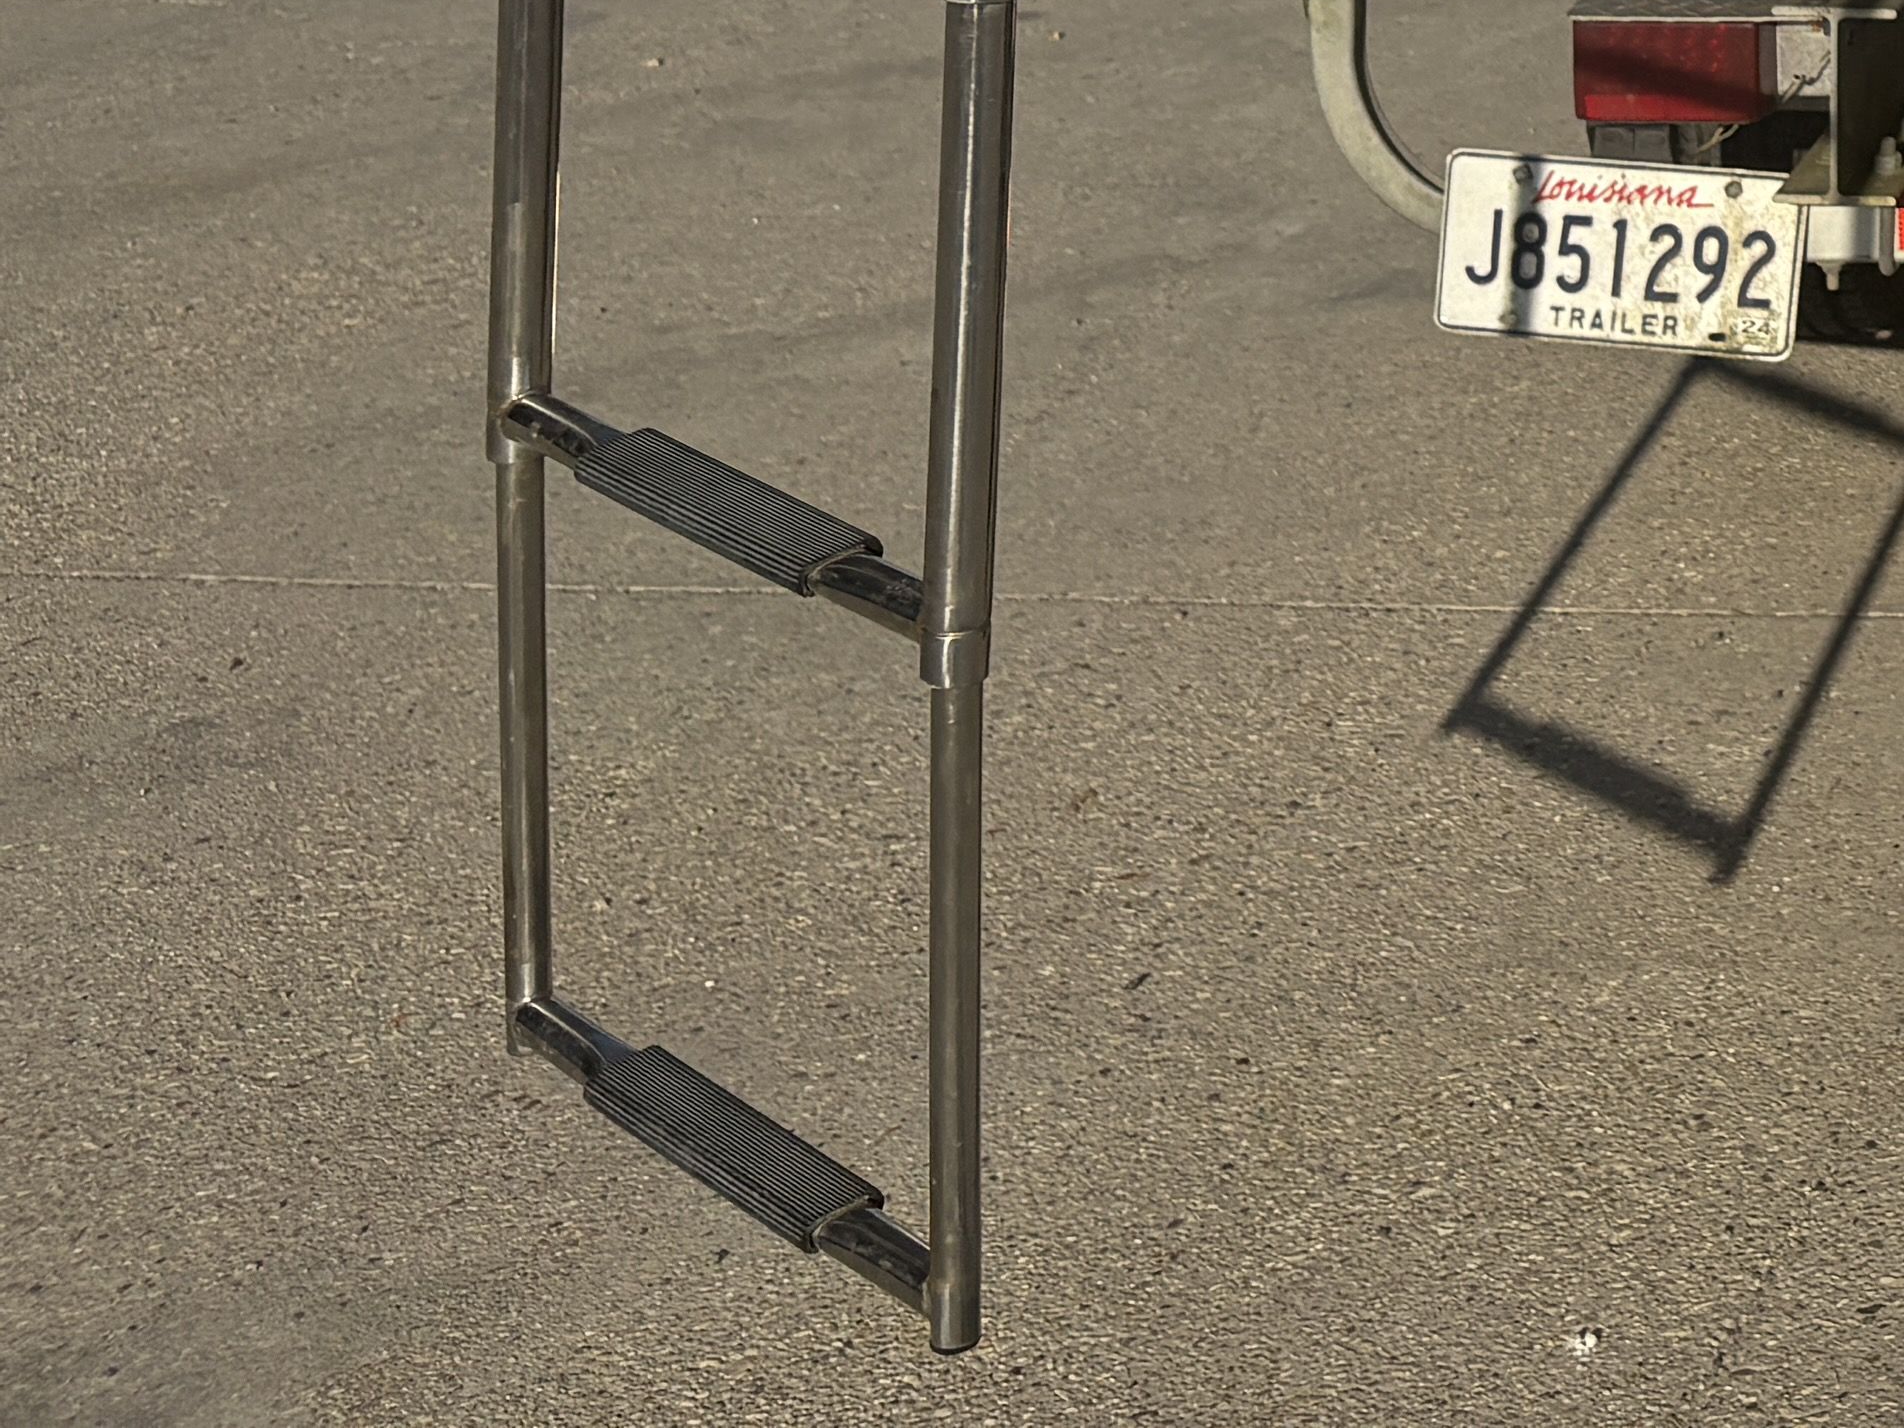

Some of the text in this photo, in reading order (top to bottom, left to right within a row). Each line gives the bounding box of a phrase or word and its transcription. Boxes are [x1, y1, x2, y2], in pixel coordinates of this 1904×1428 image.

[1531, 169, 1715, 209] Louisiana
[1464, 208, 1777, 310] J851292
[1549, 305, 1680, 337] TRAILER
[1740, 318, 1772, 337] 24
